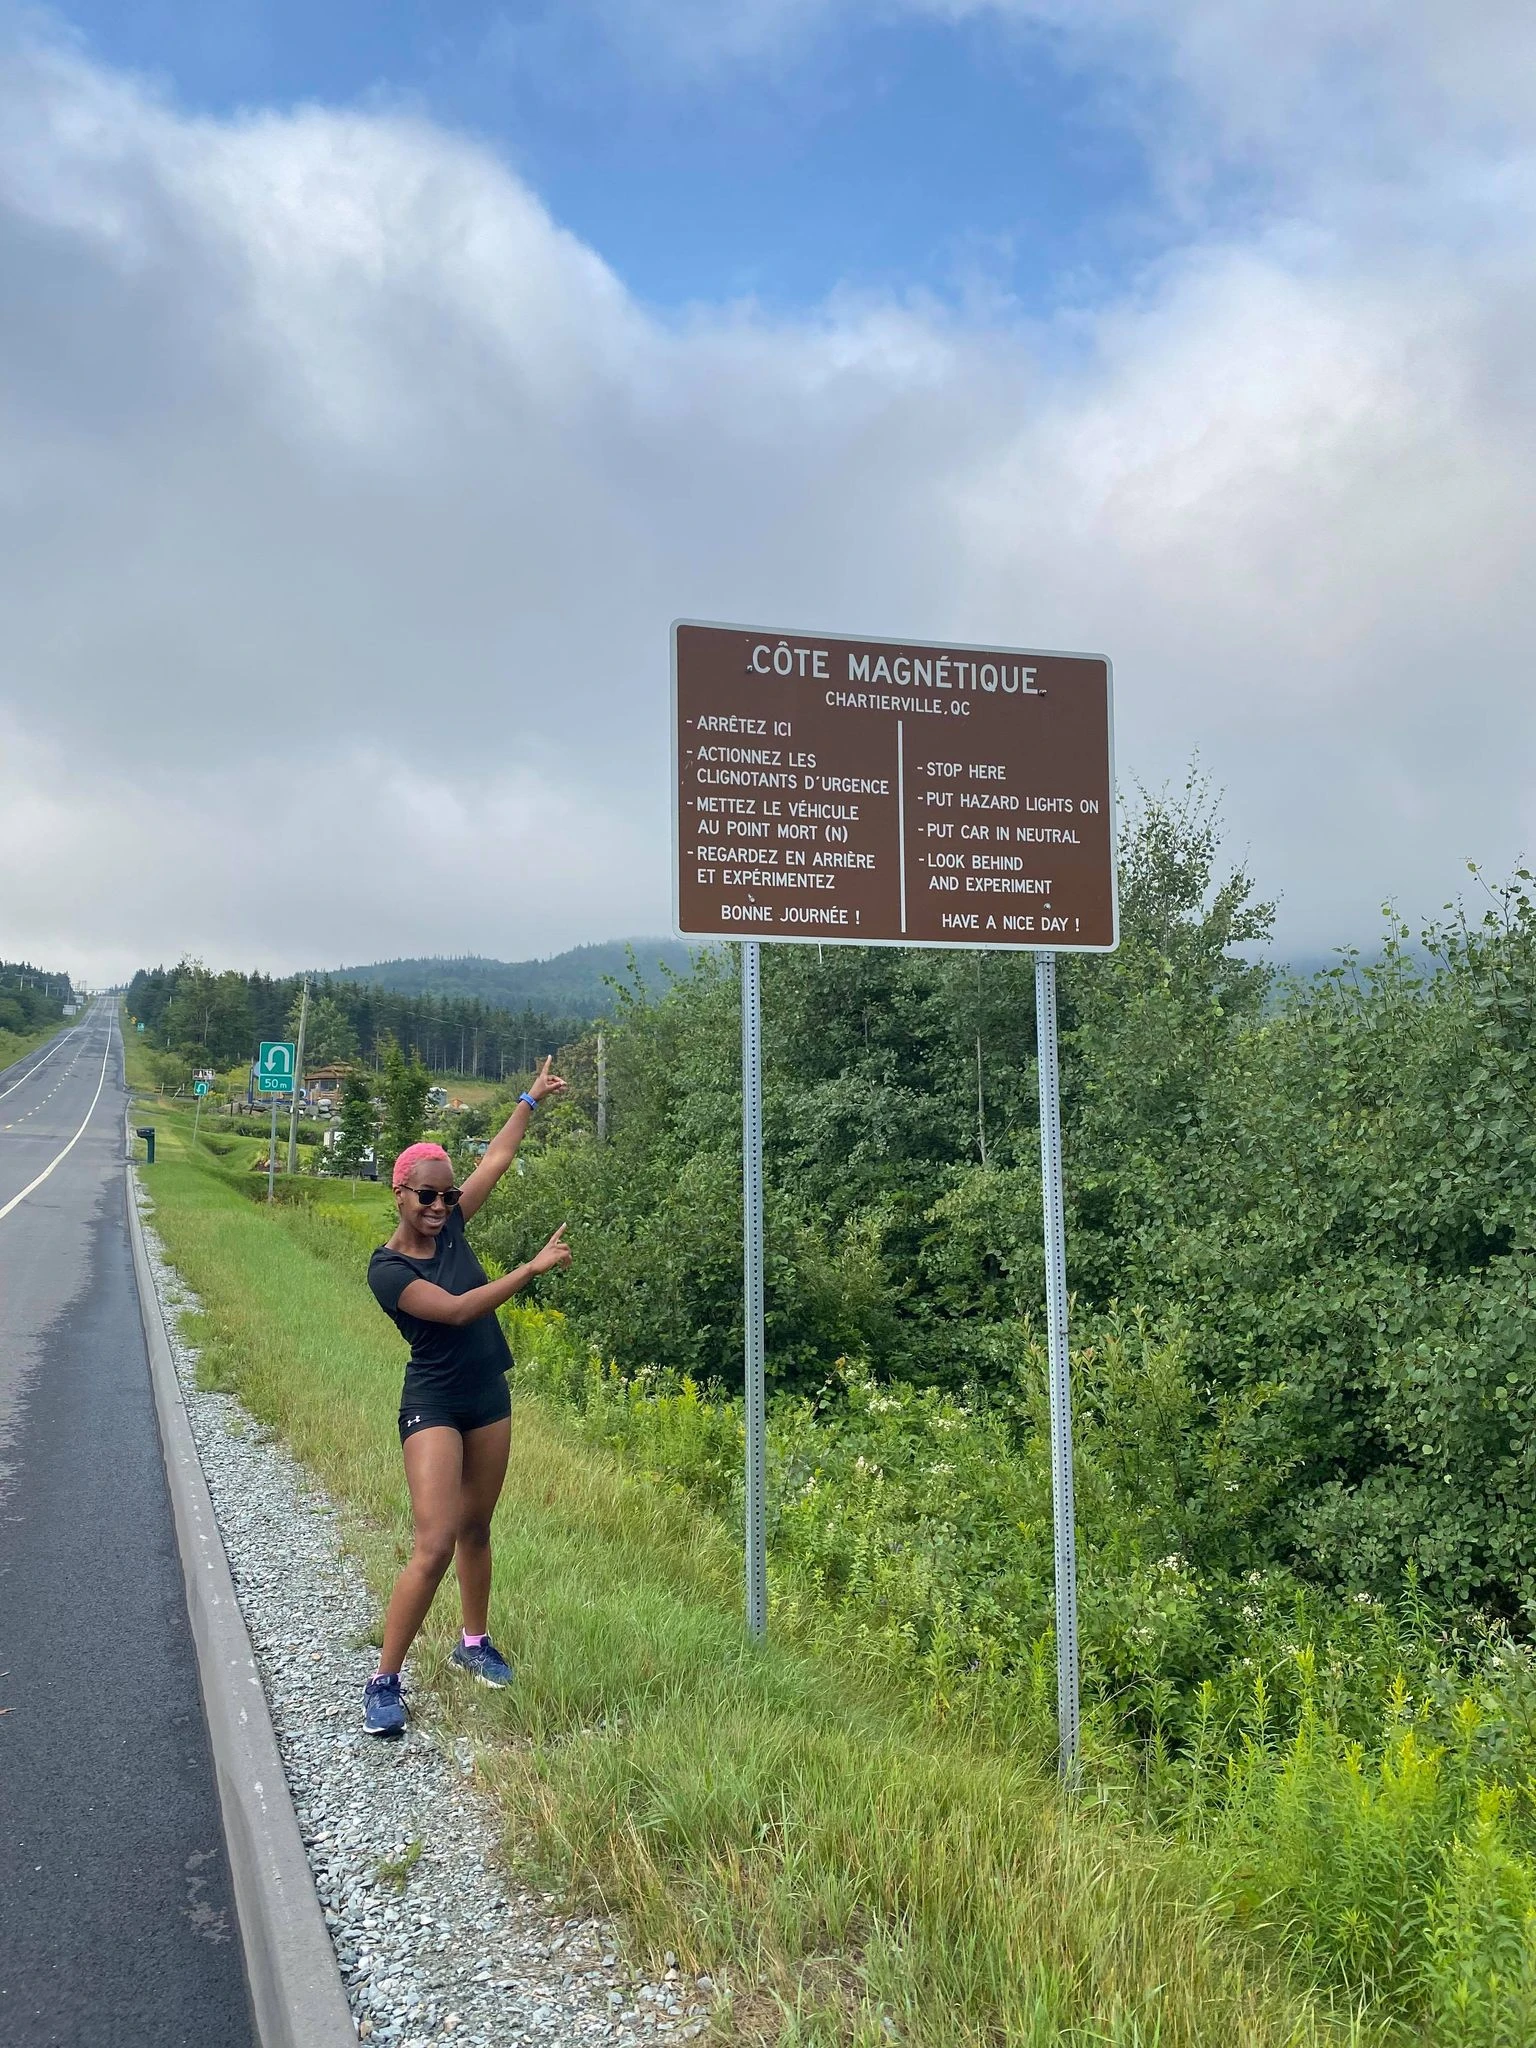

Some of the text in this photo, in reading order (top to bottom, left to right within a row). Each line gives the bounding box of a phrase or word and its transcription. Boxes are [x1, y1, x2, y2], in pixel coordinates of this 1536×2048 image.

[752, 640, 1039, 695] CÔTE MAGNÉTIQUE
[774, 720, 792, 737] ICI
[788, 751, 817, 769] LES
[696, 767, 798, 790] CLIGNOTANTS
[968, 763, 1007, 780] HERE
[763, 800, 782, 816] LE
[787, 799, 860, 821] VÉHICULE
[960, 793, 1020, 811] HAZARD
[1025, 796, 1074, 813] LIGHTS
[1079, 799, 1099, 814] ON
[697, 818, 849, 844] AU POINT MORT (N)
[960, 824, 990, 840] CAR
[996, 826, 1010, 841] IN
[1016, 827, 1081, 844] NEUTRAL
[785, 850, 806, 866] EN
[811, 849, 876, 870] ARRIÈRE
[971, 854, 1024, 871] BEHIND
[697, 867, 836, 890] ET EXPÉRIMENTEZ
[928, 875, 1053, 895] AND EXPERIMENT
[721, 904, 773, 922] BONNE
[779, 904, 849, 925] JOURNÉE
[942, 913, 980, 930] HAVE
[985, 914, 997, 930] A
[1003, 915, 1035, 931] NICE
[1041, 916, 1069, 932] DAY
[265, 1079, 278, 1088] 50
